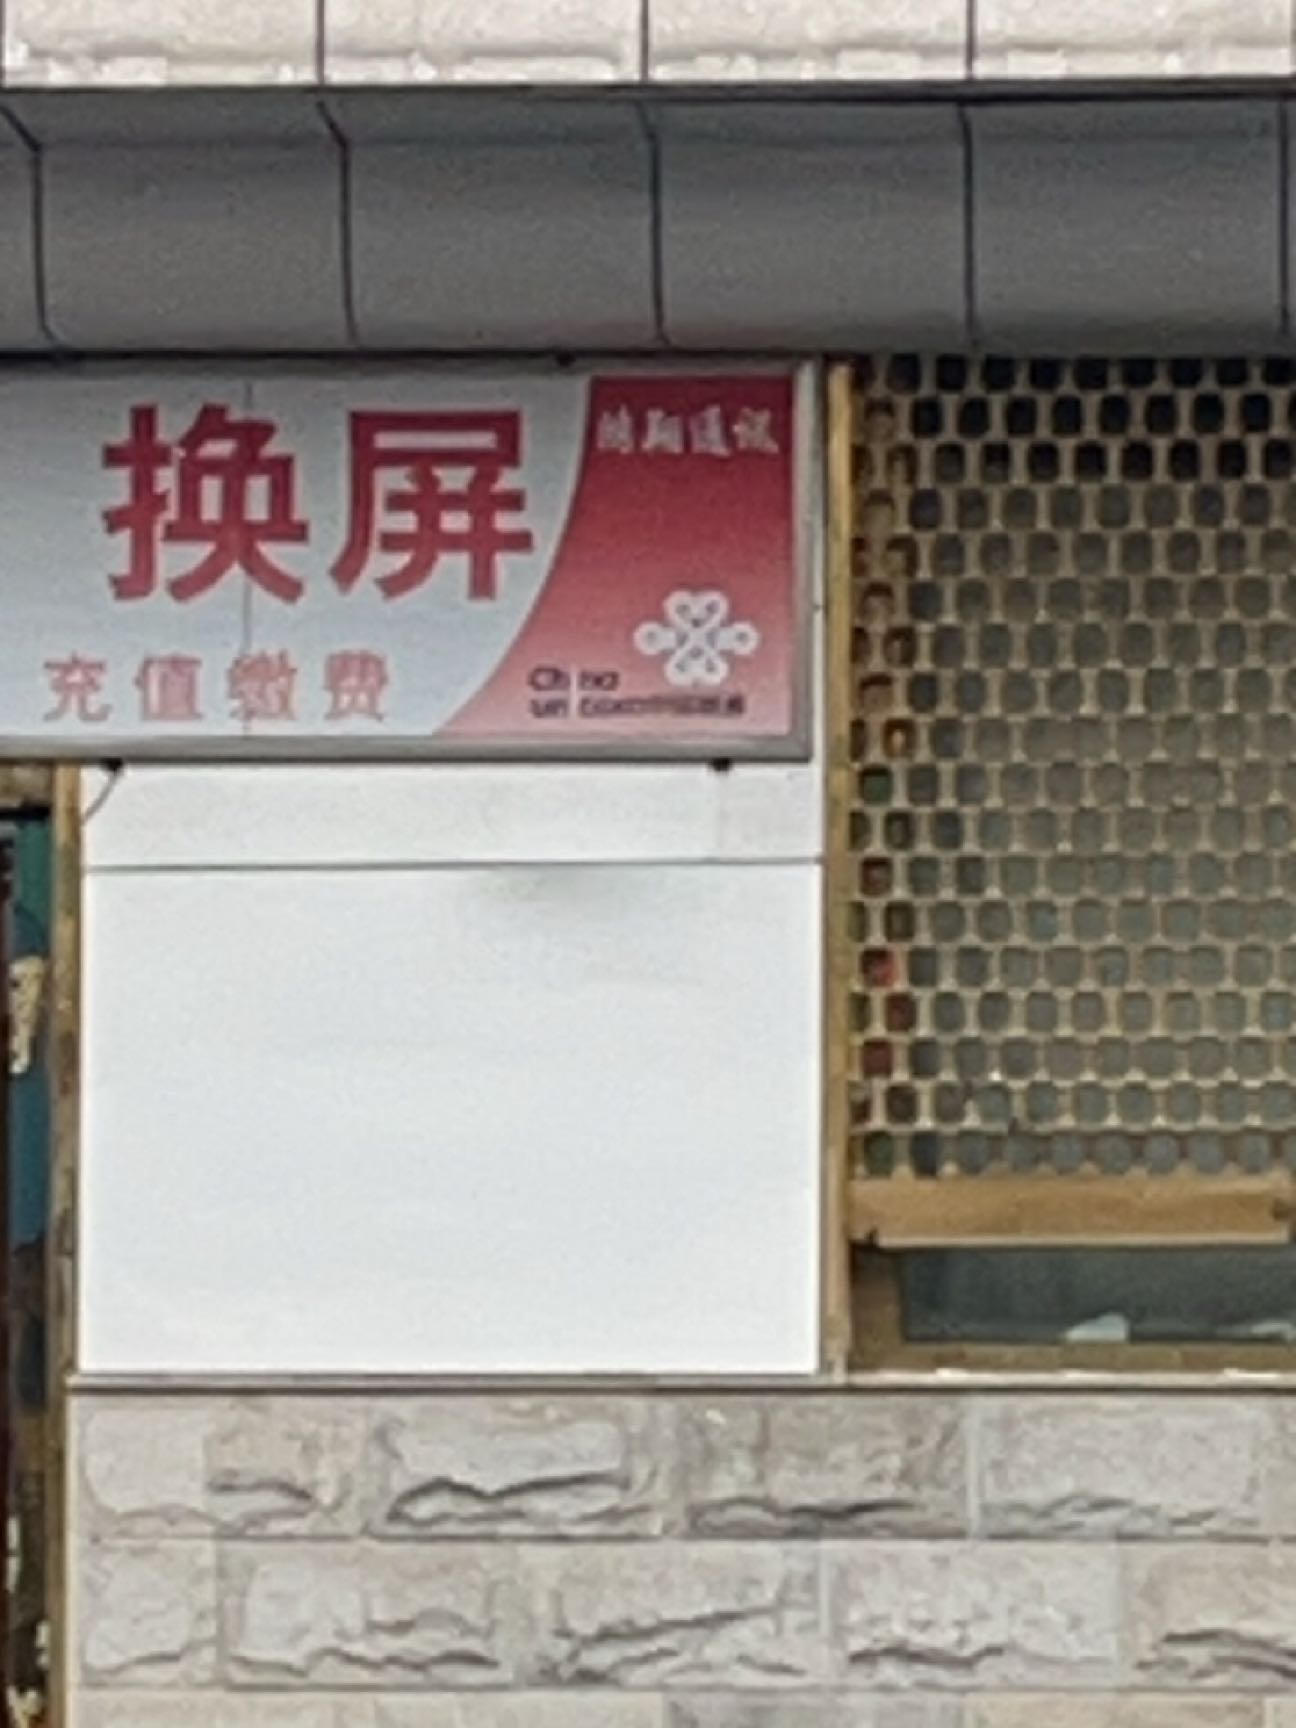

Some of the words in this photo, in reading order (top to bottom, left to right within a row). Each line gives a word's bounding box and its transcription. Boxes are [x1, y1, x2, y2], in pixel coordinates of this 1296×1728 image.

[103, 404, 534, 603] 换屏
[42, 648, 390, 722] 充值缴费
